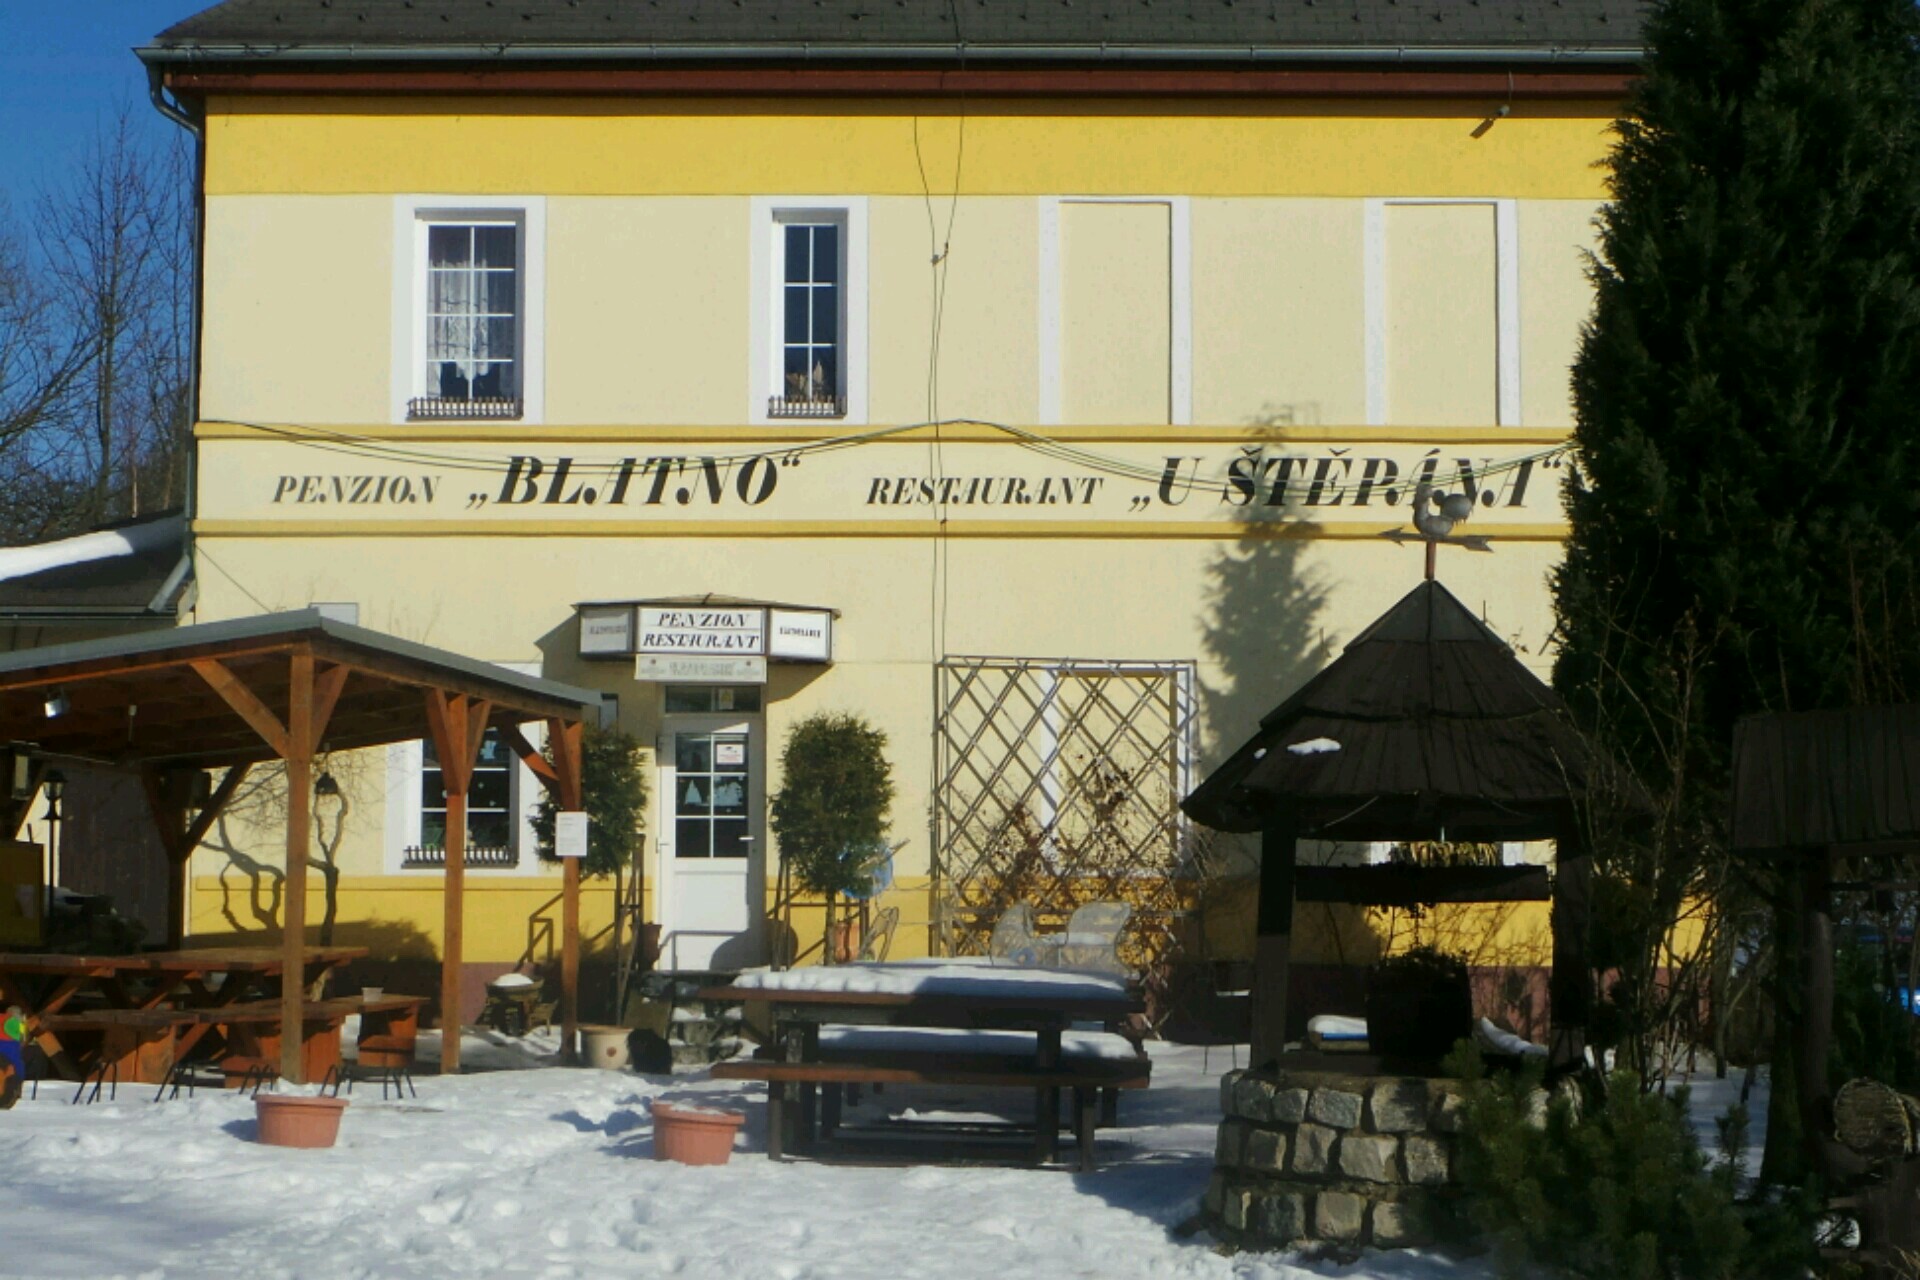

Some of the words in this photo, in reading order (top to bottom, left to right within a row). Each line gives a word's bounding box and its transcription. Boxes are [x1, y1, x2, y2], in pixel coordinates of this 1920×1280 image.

[272, 475, 441, 504] PENZION
[866, 477, 1104, 505] RESTAURANT
[657, 612, 749, 627] PENZION
